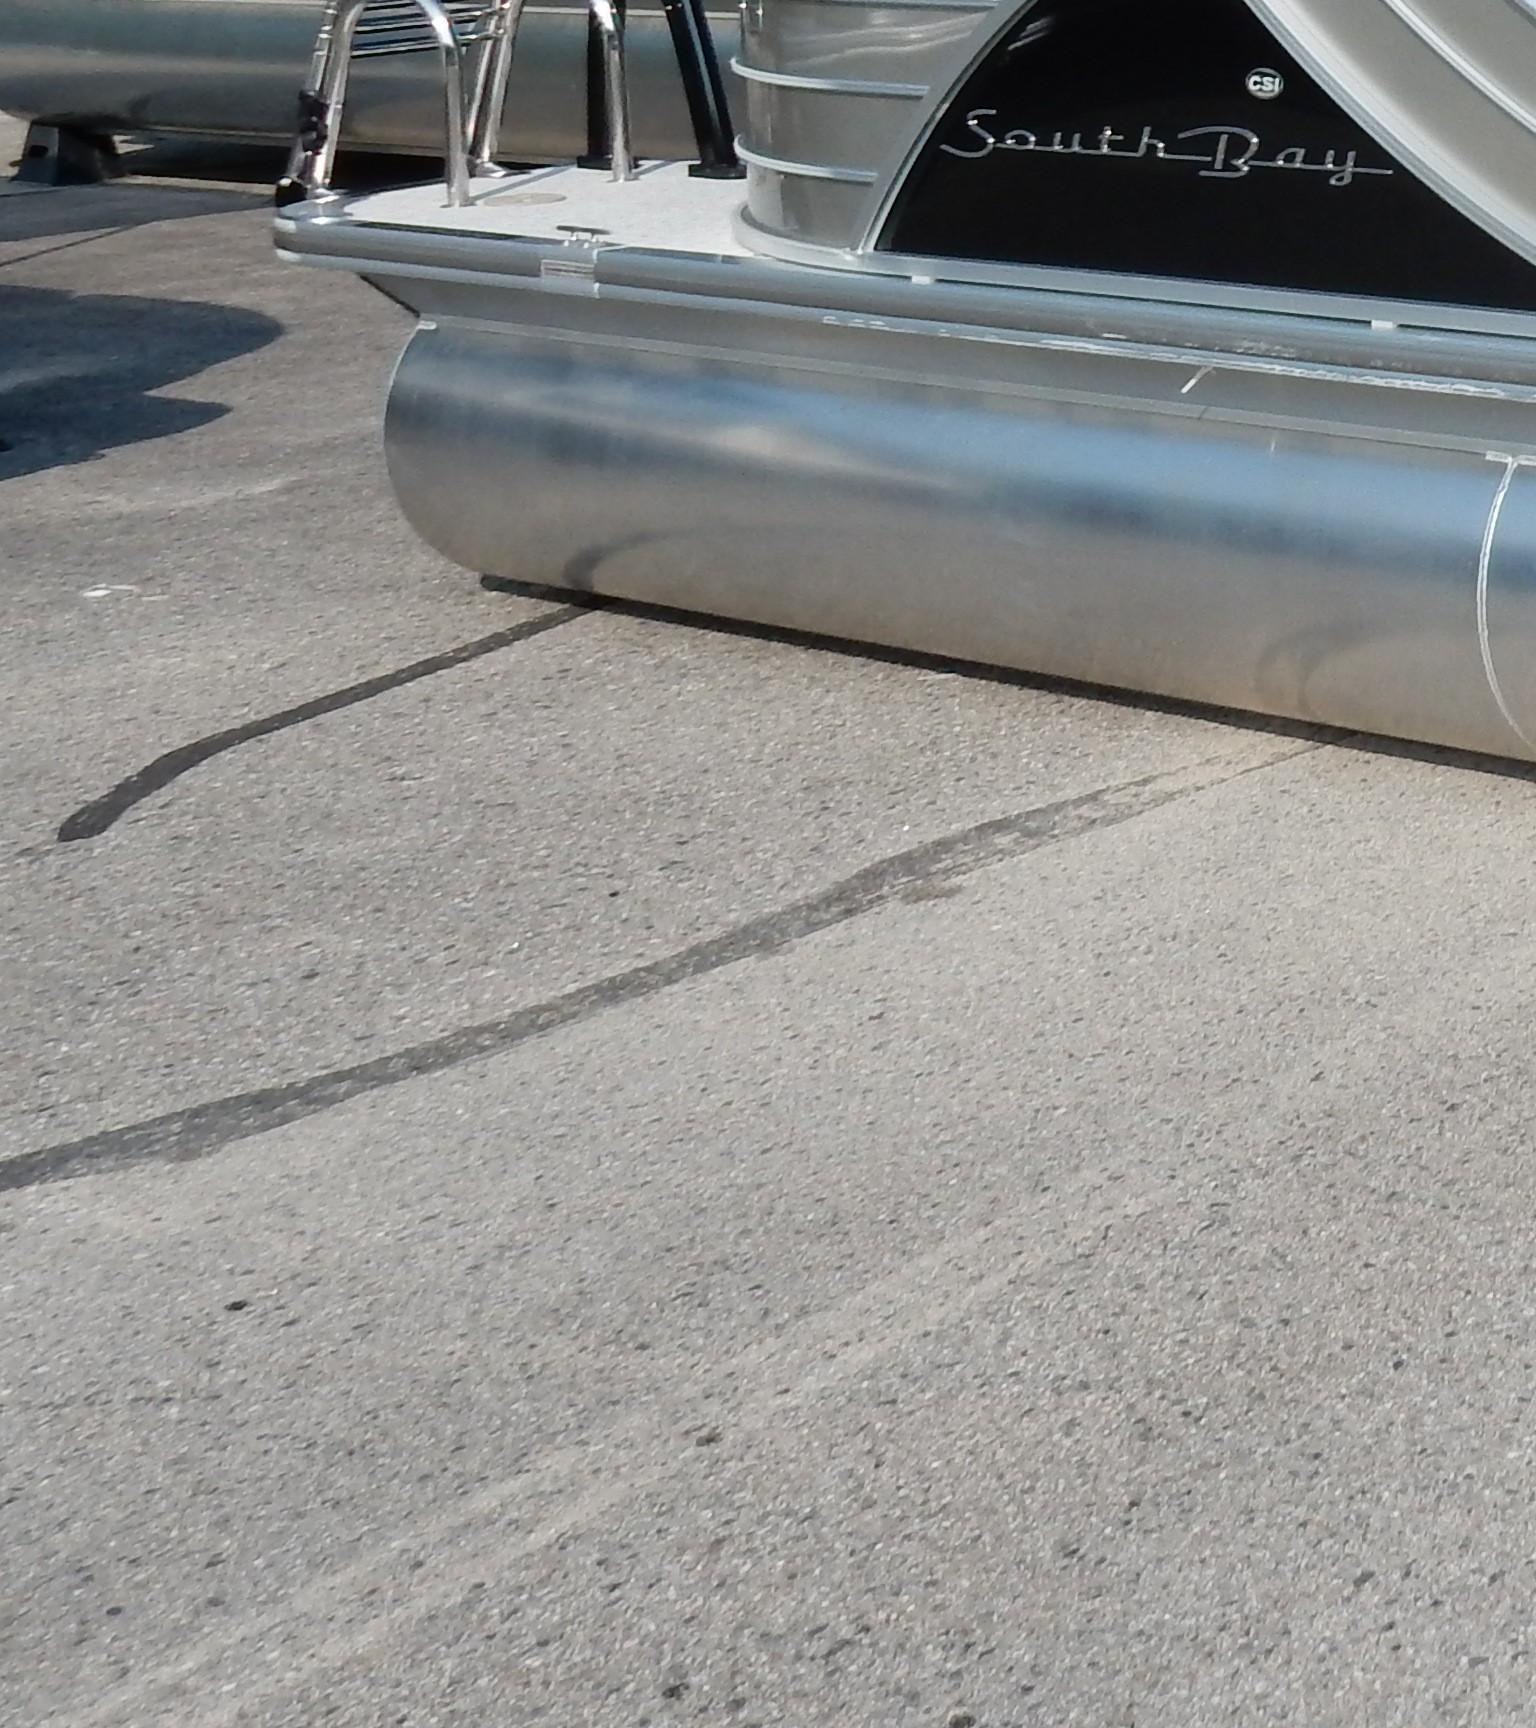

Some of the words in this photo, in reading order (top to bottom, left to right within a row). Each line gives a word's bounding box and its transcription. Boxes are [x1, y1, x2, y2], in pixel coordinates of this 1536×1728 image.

[1247, 74, 1281, 92] CSI
[939, 109, 1195, 159] South
[1177, 126, 1394, 186] Bay
